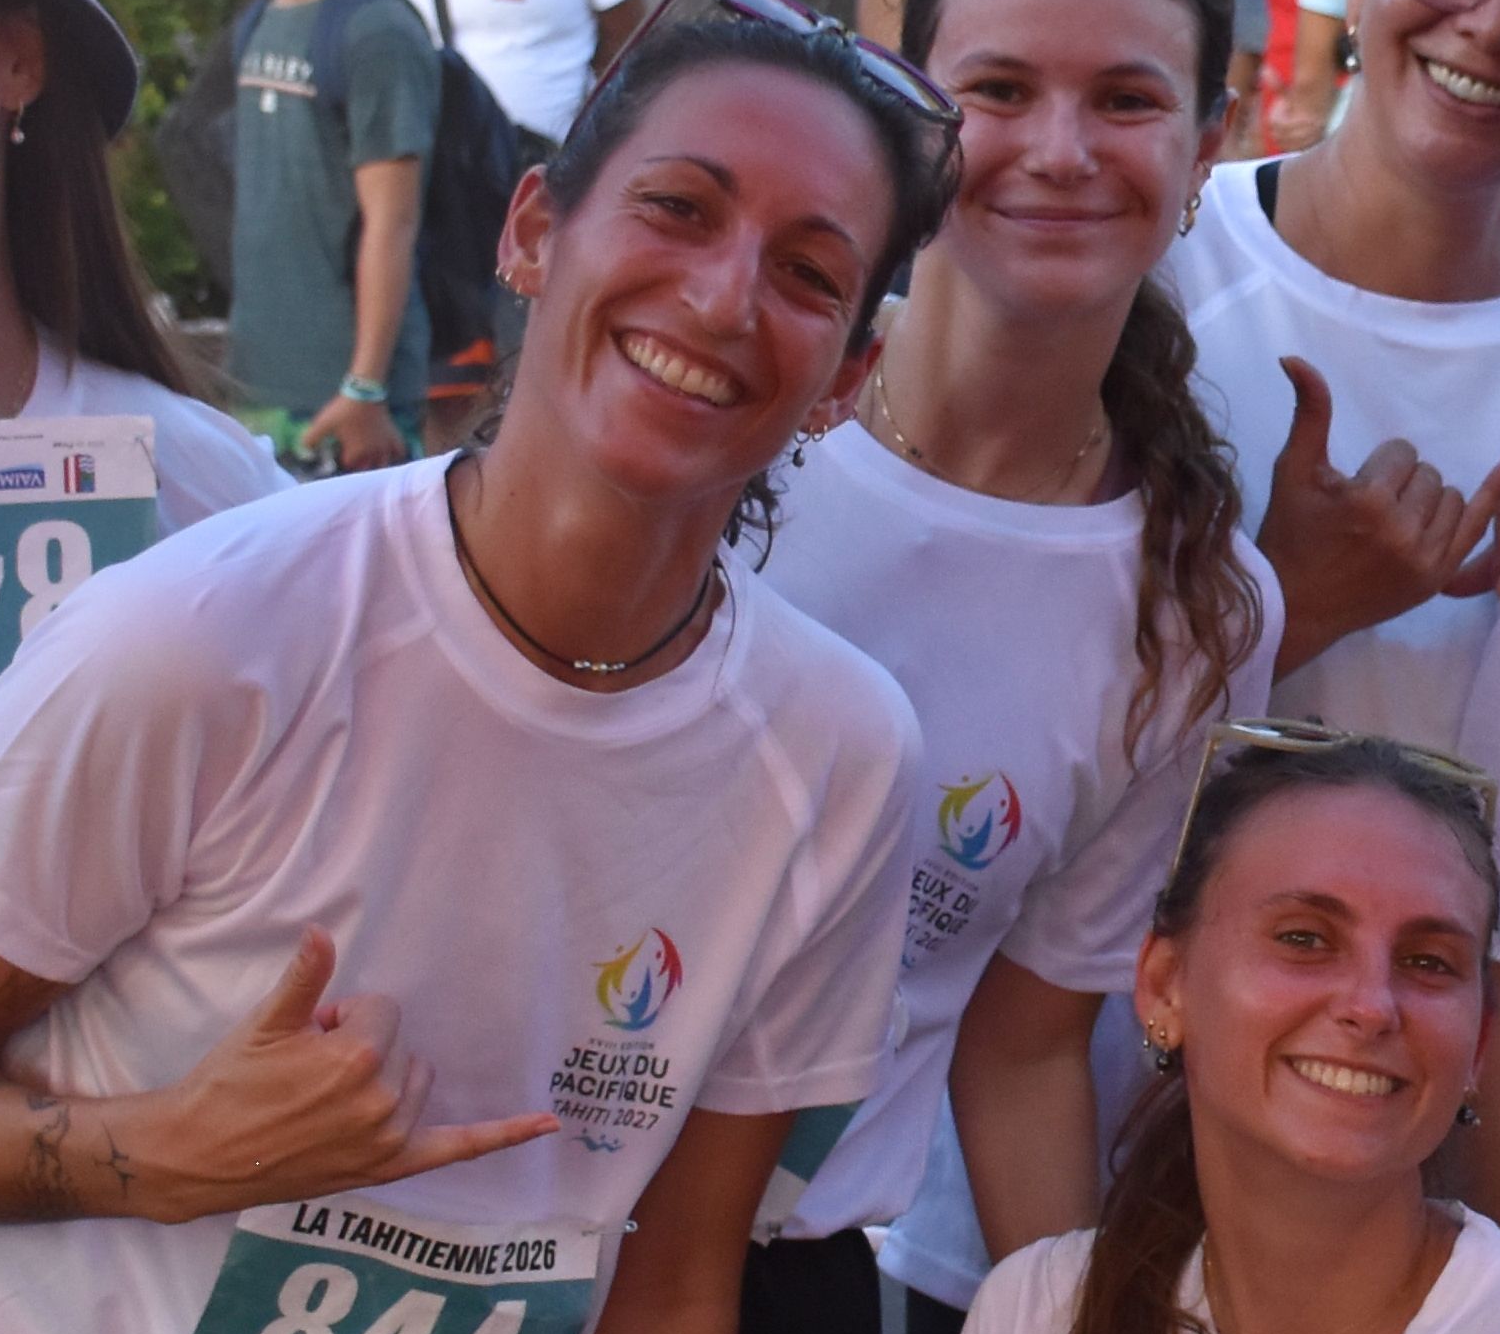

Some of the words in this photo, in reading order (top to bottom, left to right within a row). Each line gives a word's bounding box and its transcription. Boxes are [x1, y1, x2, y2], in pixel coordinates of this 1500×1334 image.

[911, 866, 954, 903] EUX
[564, 1047, 630, 1076] JEUX
[634, 1055, 670, 1079] DU
[550, 1071, 678, 1109] PACIFIQUE
[552, 1099, 610, 1125] TAHITI
[613, 1108, 660, 1130] 2027
[292, 1202, 330, 1236] LA
[338, 1211, 500, 1275] TAHITIENNE
[501, 1239, 557, 1273] 2026
